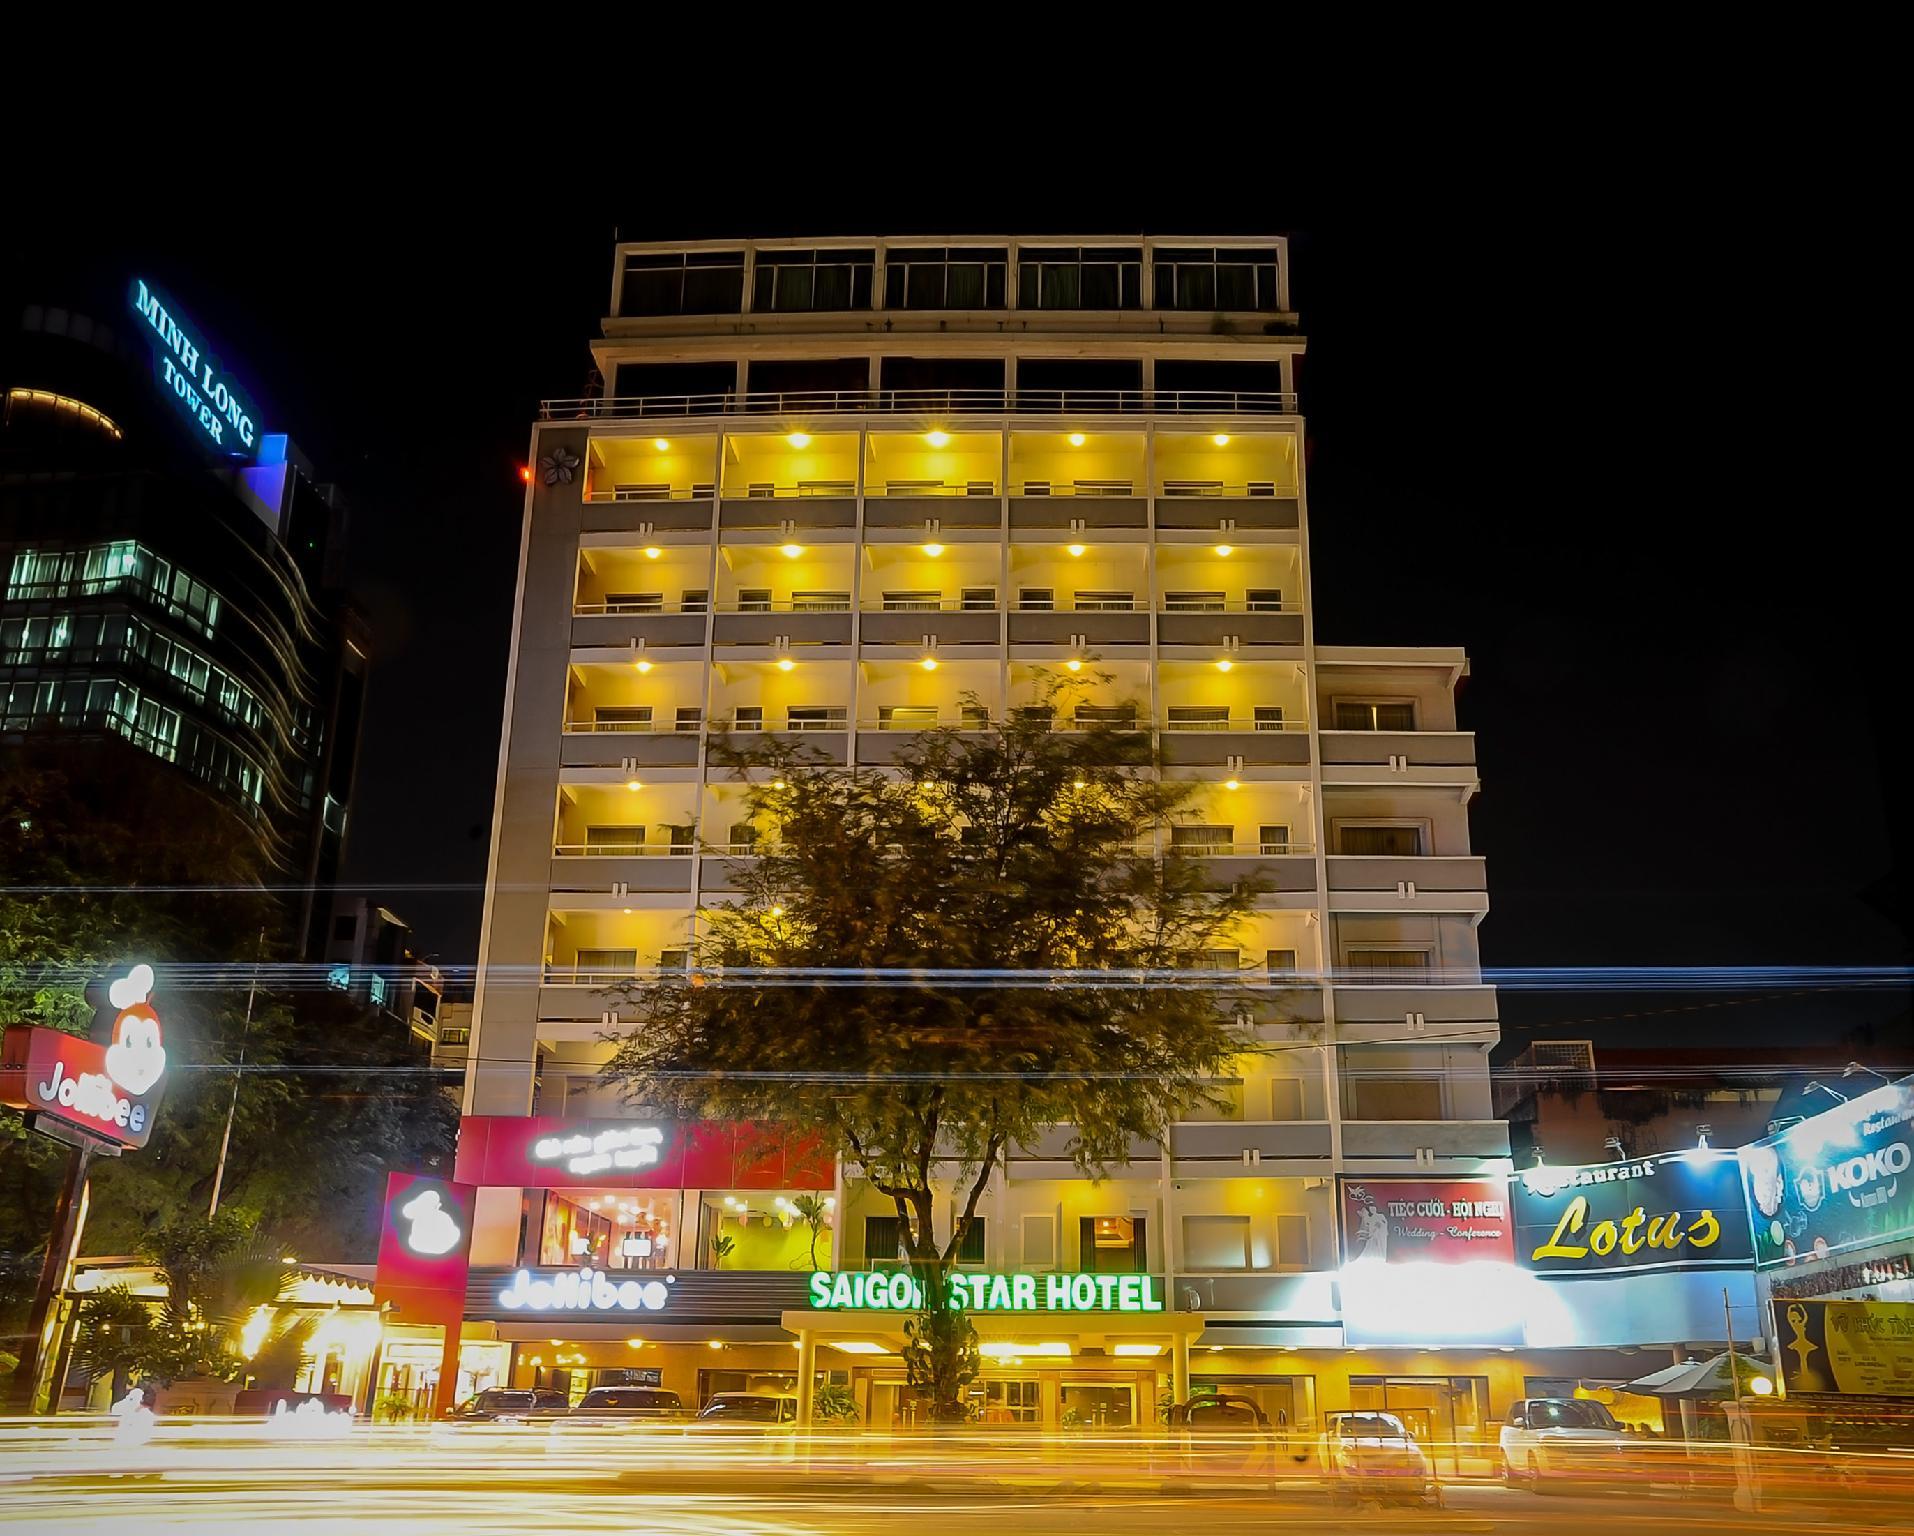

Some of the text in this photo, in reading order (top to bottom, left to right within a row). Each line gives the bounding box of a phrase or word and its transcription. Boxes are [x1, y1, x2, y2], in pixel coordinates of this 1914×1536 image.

[136, 280, 254, 447] MINH LONG
[163, 356, 223, 445] TOWER
[1863, 1109, 1914, 1136] Restauran
[1827, 1142, 1911, 1193] KOKO
[1387, 1198, 1415, 1221] TIỆC
[1532, 1195, 1721, 1261] Lotus
[1394, 1226, 1437, 1241] Wedding
[1446, 1226, 1502, 1241] Conference
[499, 1267, 668, 1310] Jollibee
[949, 1273, 1036, 1311] STAR
[1047, 1273, 1162, 1311] HOTEL
